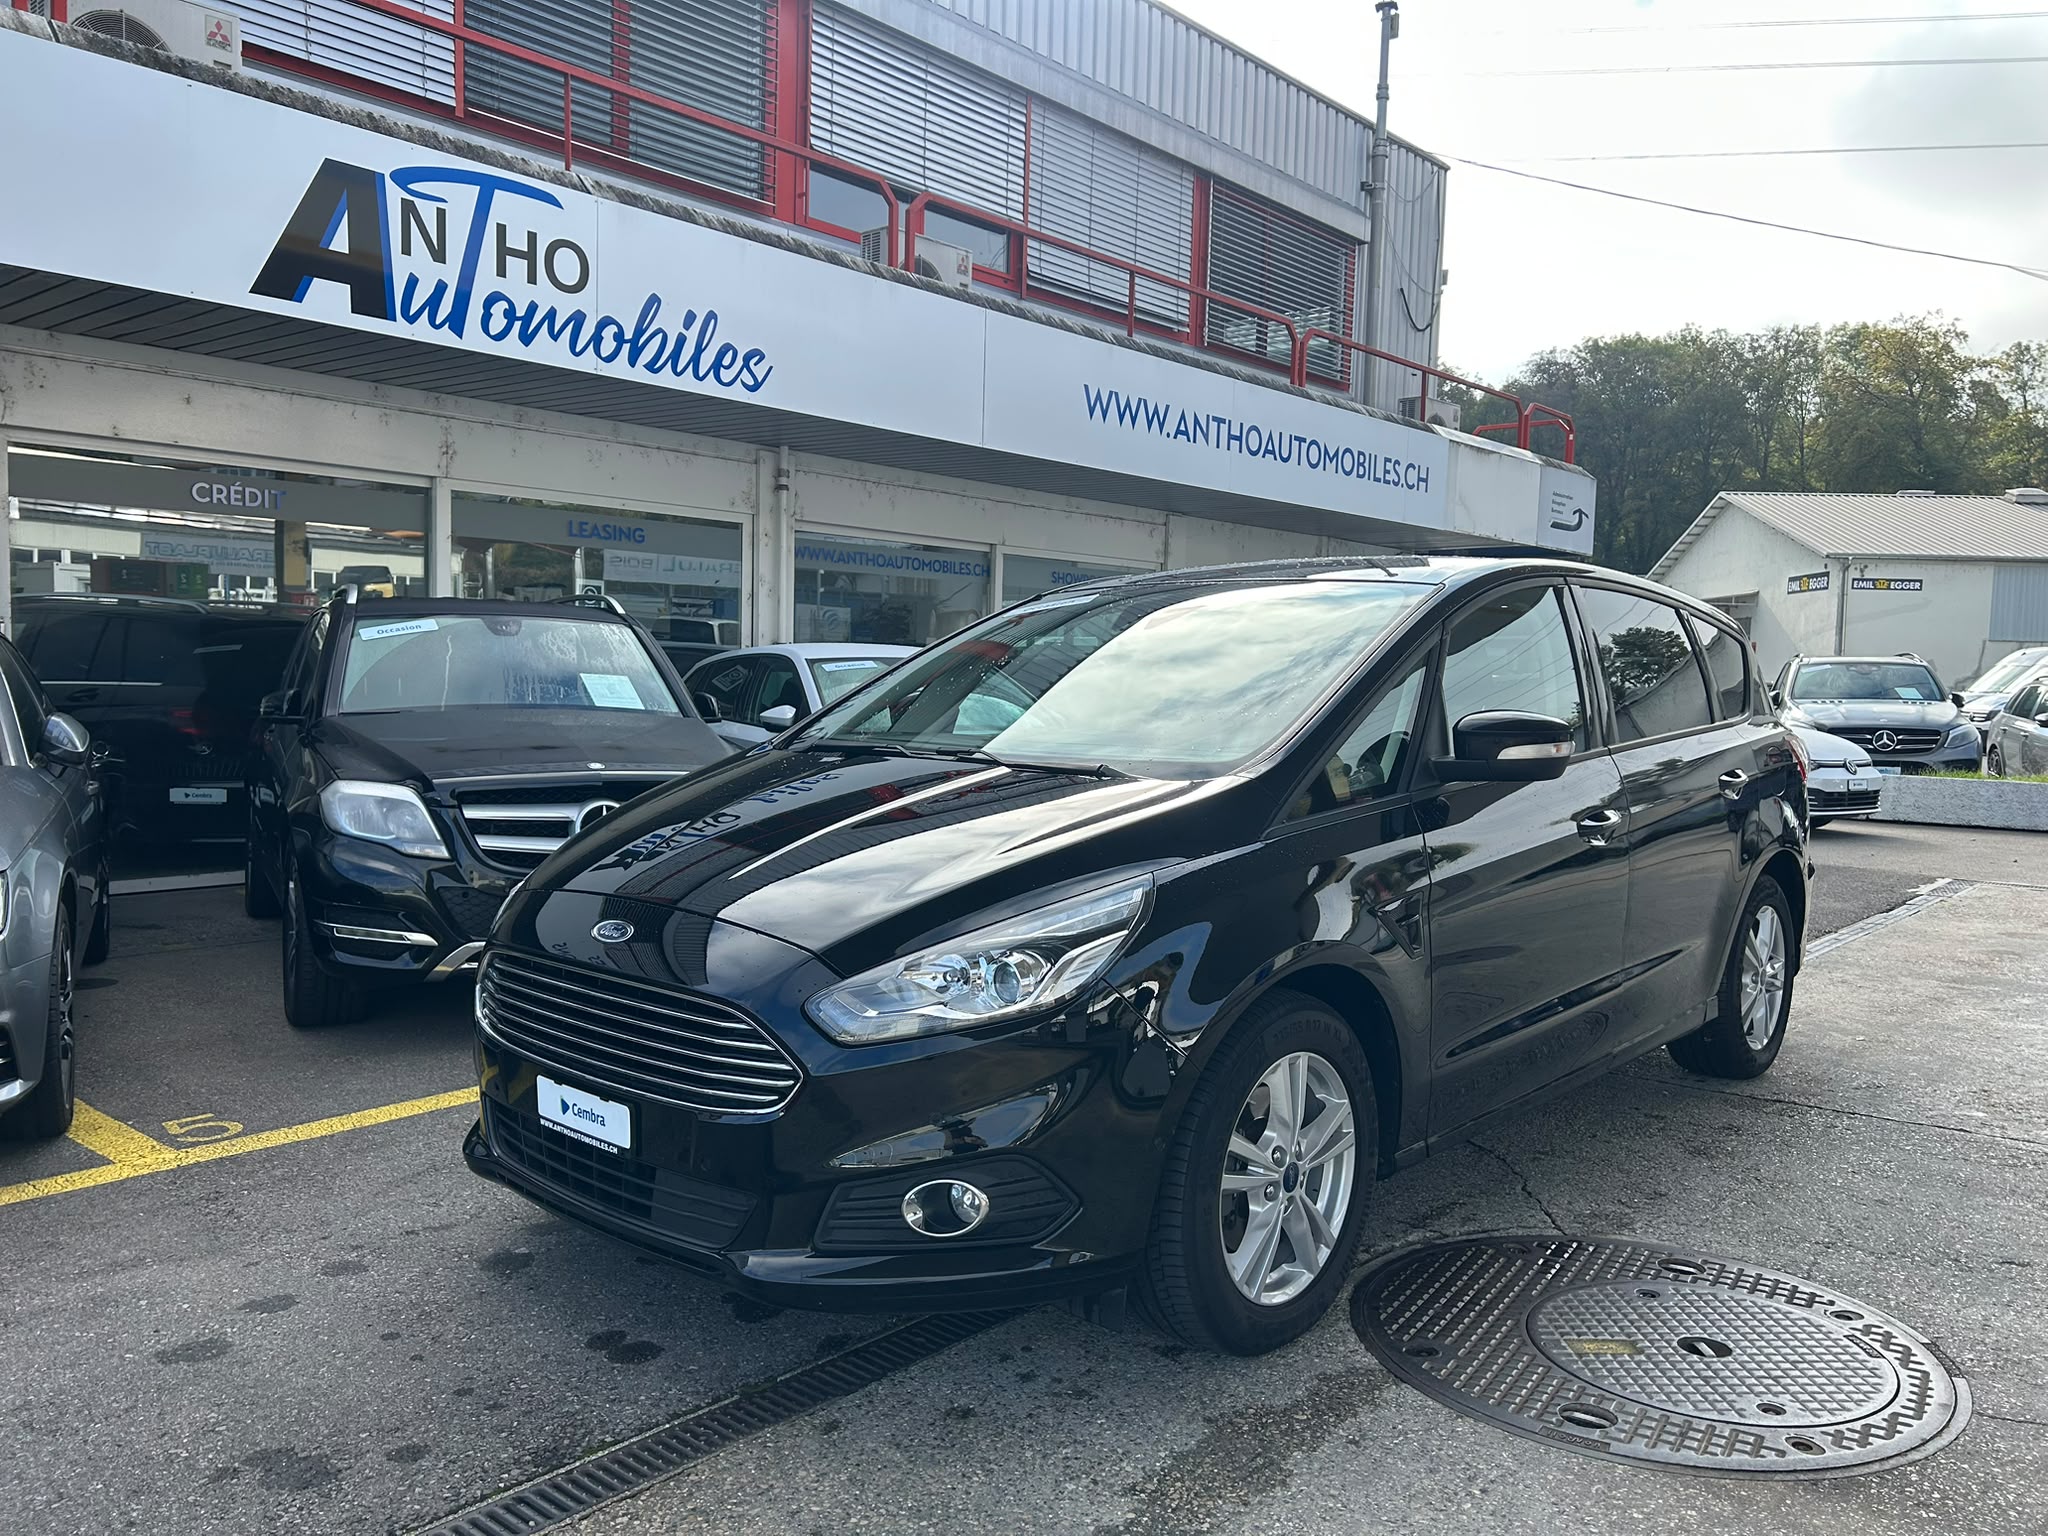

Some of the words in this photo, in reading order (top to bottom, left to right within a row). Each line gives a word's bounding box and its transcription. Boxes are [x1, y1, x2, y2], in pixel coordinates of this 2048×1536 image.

[1083, 383, 1430, 493] WWW.ANTHOAUTOMOBILES.CH
[191, 482, 287, 511] CRÉDIT
[568, 520, 646, 544] LEASING
[795, 546, 991, 577] WWW.ANTHOAUTOMOBILES.CH
[1788, 580, 1800, 592] EMIL
[1809, 576, 1828, 589] EGGER
[1853, 580, 1875, 589] EMIL
[1890, 581, 1921, 590] EGGER
[376, 624, 422, 635] Occasion
[161, 1112, 244, 1143] 5
[571, 1102, 607, 1127] Cembra
[539, 1117, 619, 1155] WWW.ANTHOAUTOMOBILES.CH
